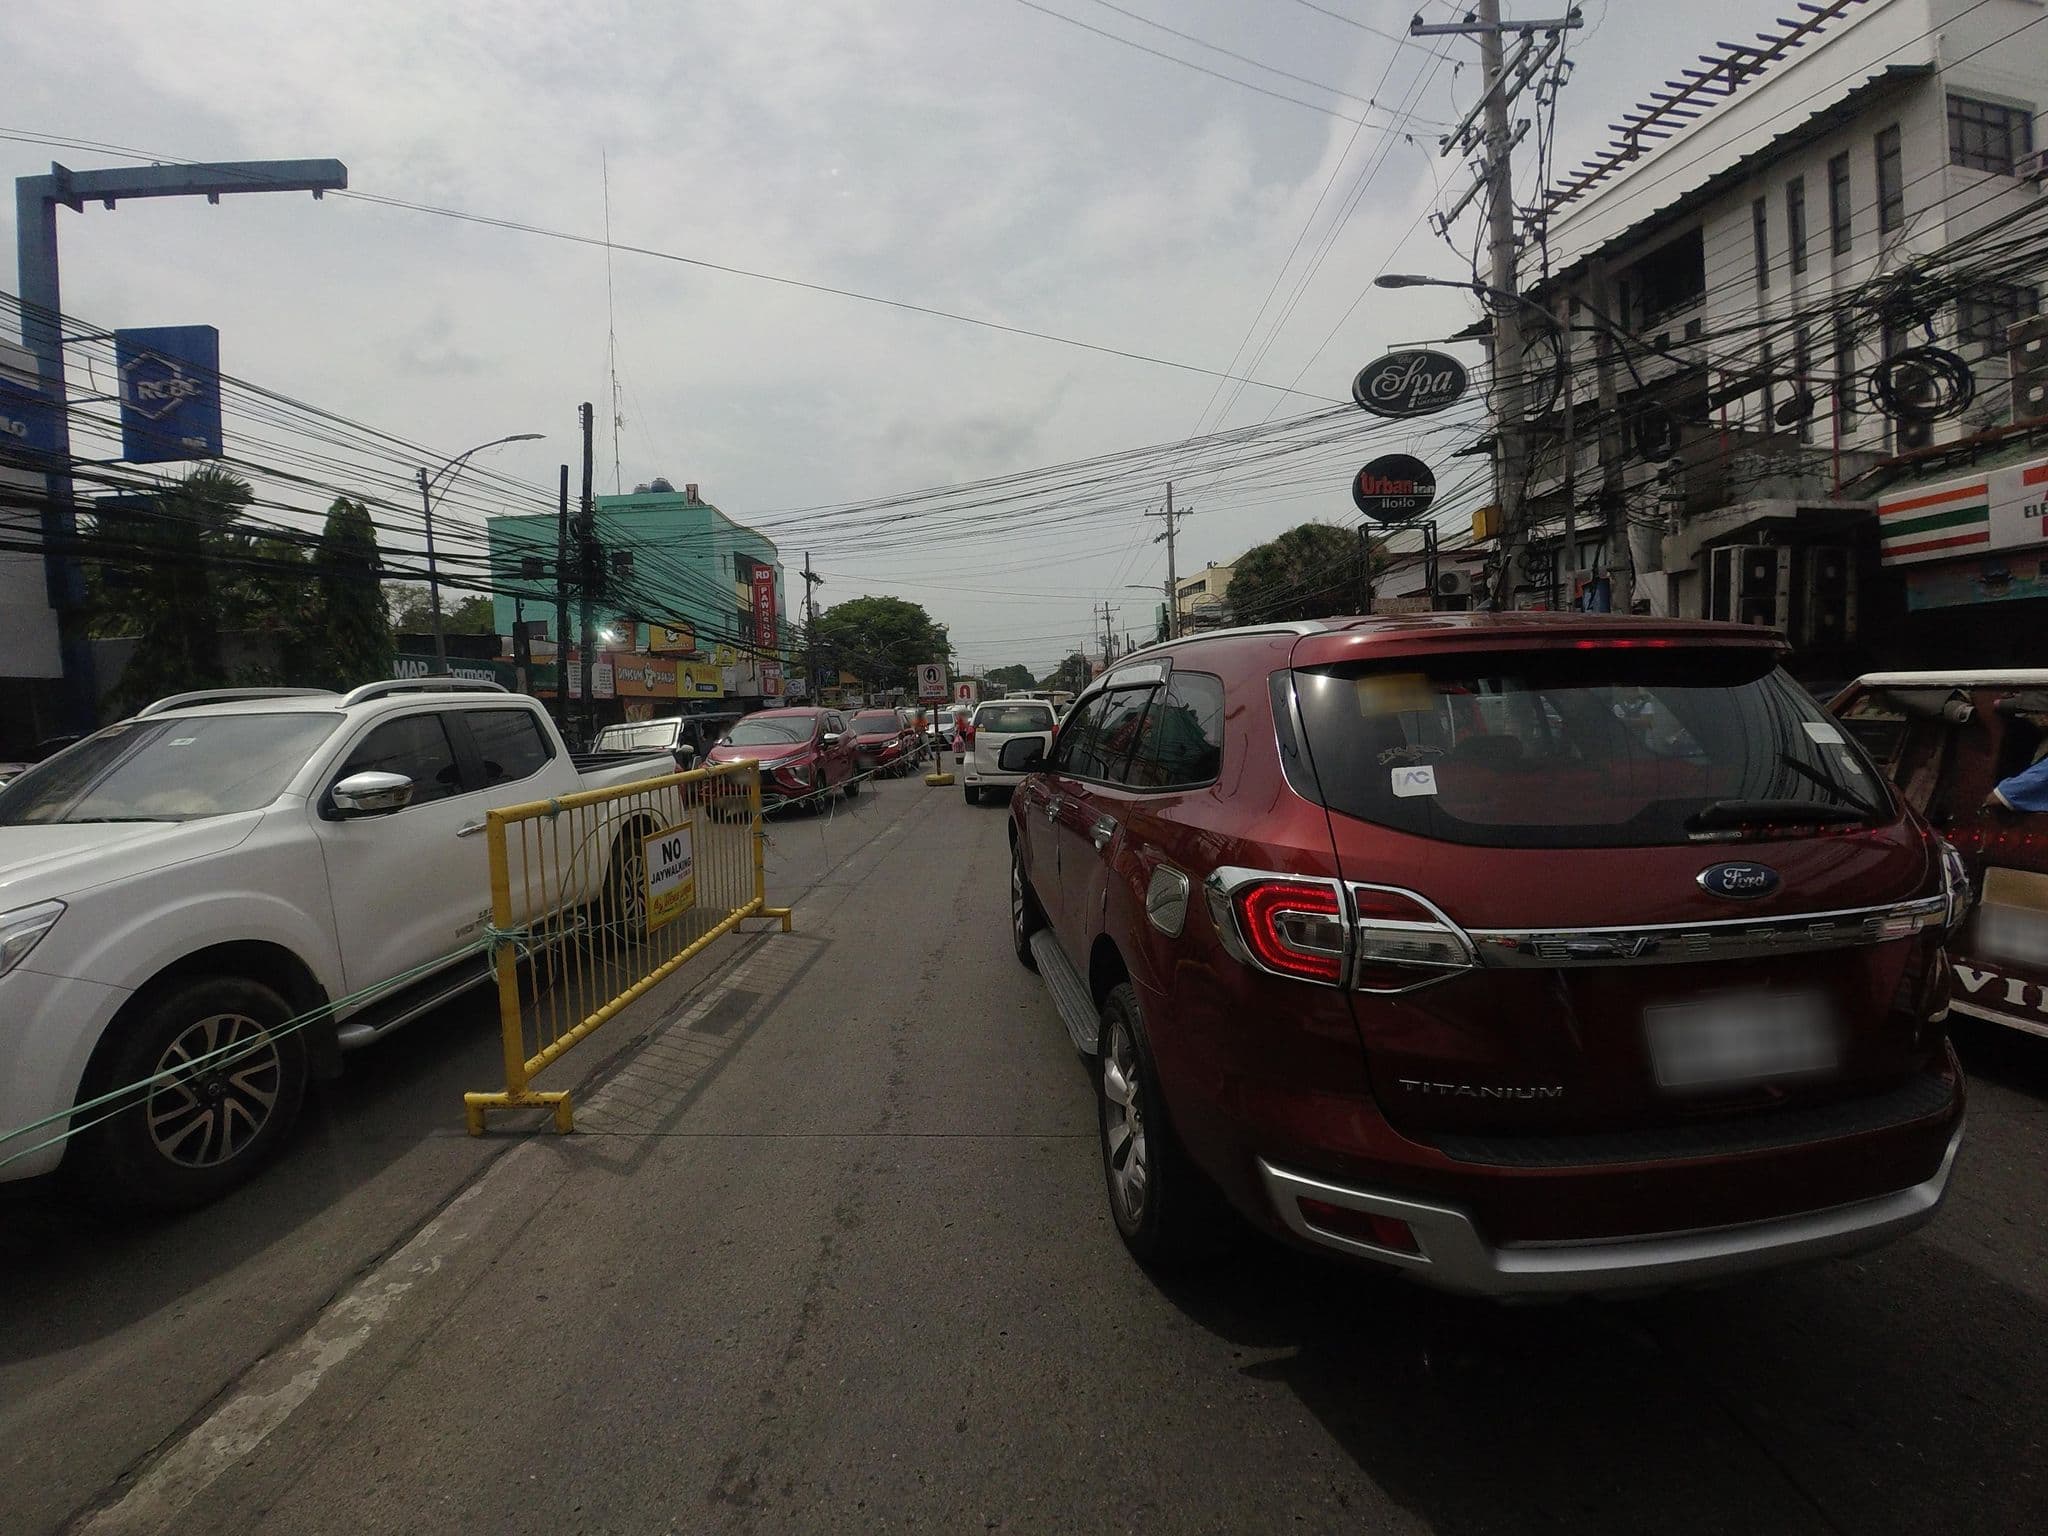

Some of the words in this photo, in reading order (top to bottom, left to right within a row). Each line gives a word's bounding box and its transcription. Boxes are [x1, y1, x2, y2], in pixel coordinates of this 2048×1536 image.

[1371, 356, 1453, 408] Spa
[1360, 472, 1413, 495] Urban
[1413, 482, 1435, 494] inn
[755, 570, 770, 580] RD
[446, 663, 496, 682] harmacy
[662, 838, 681, 865] NO
[651, 857, 692, 885] JAYWALKING
[1723, 867, 1766, 890] Ford
[1399, 1079, 1564, 1099] TITANIUM
